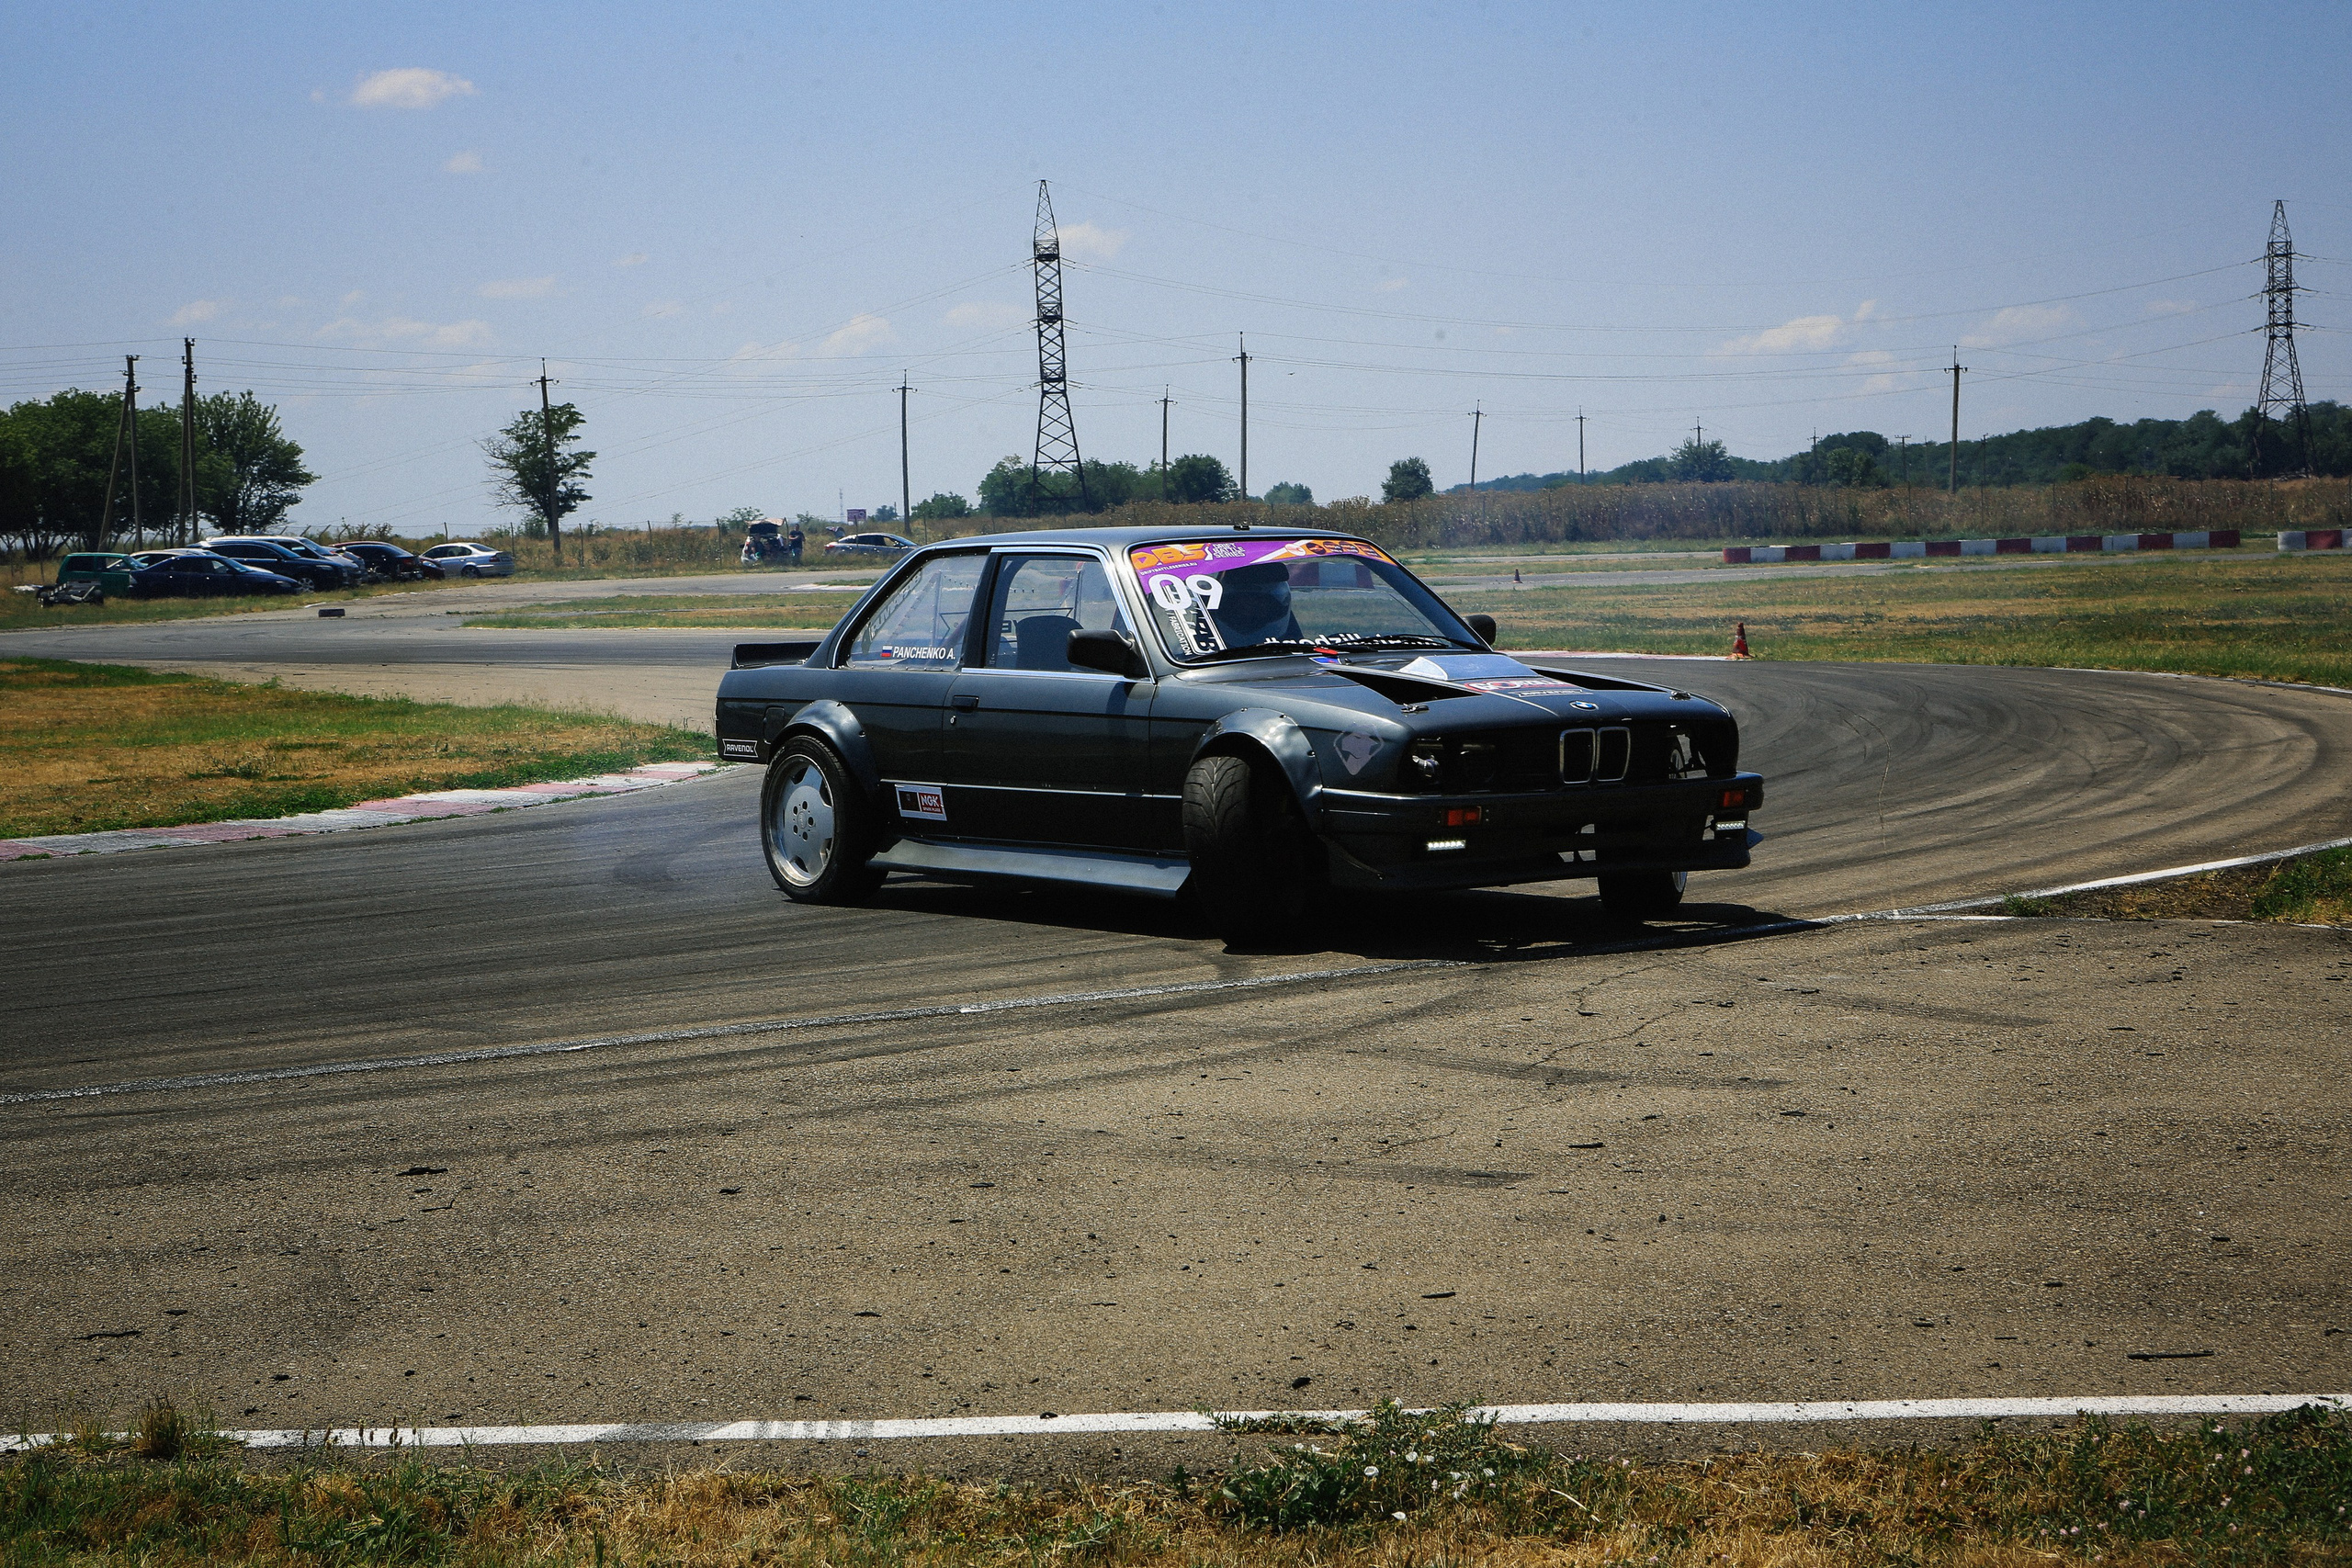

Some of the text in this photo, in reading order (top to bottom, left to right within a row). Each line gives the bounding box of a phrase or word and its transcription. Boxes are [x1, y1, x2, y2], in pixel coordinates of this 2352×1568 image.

[1131, 544, 1206, 570] DBS
[1148, 573, 1223, 610] 09
[1169, 615, 1193, 656] FABRICATION
[892, 646, 956, 660] PANCHENKO A.
[726, 743, 754, 753] RAVENOL
[921, 795, 940, 807] NGK
